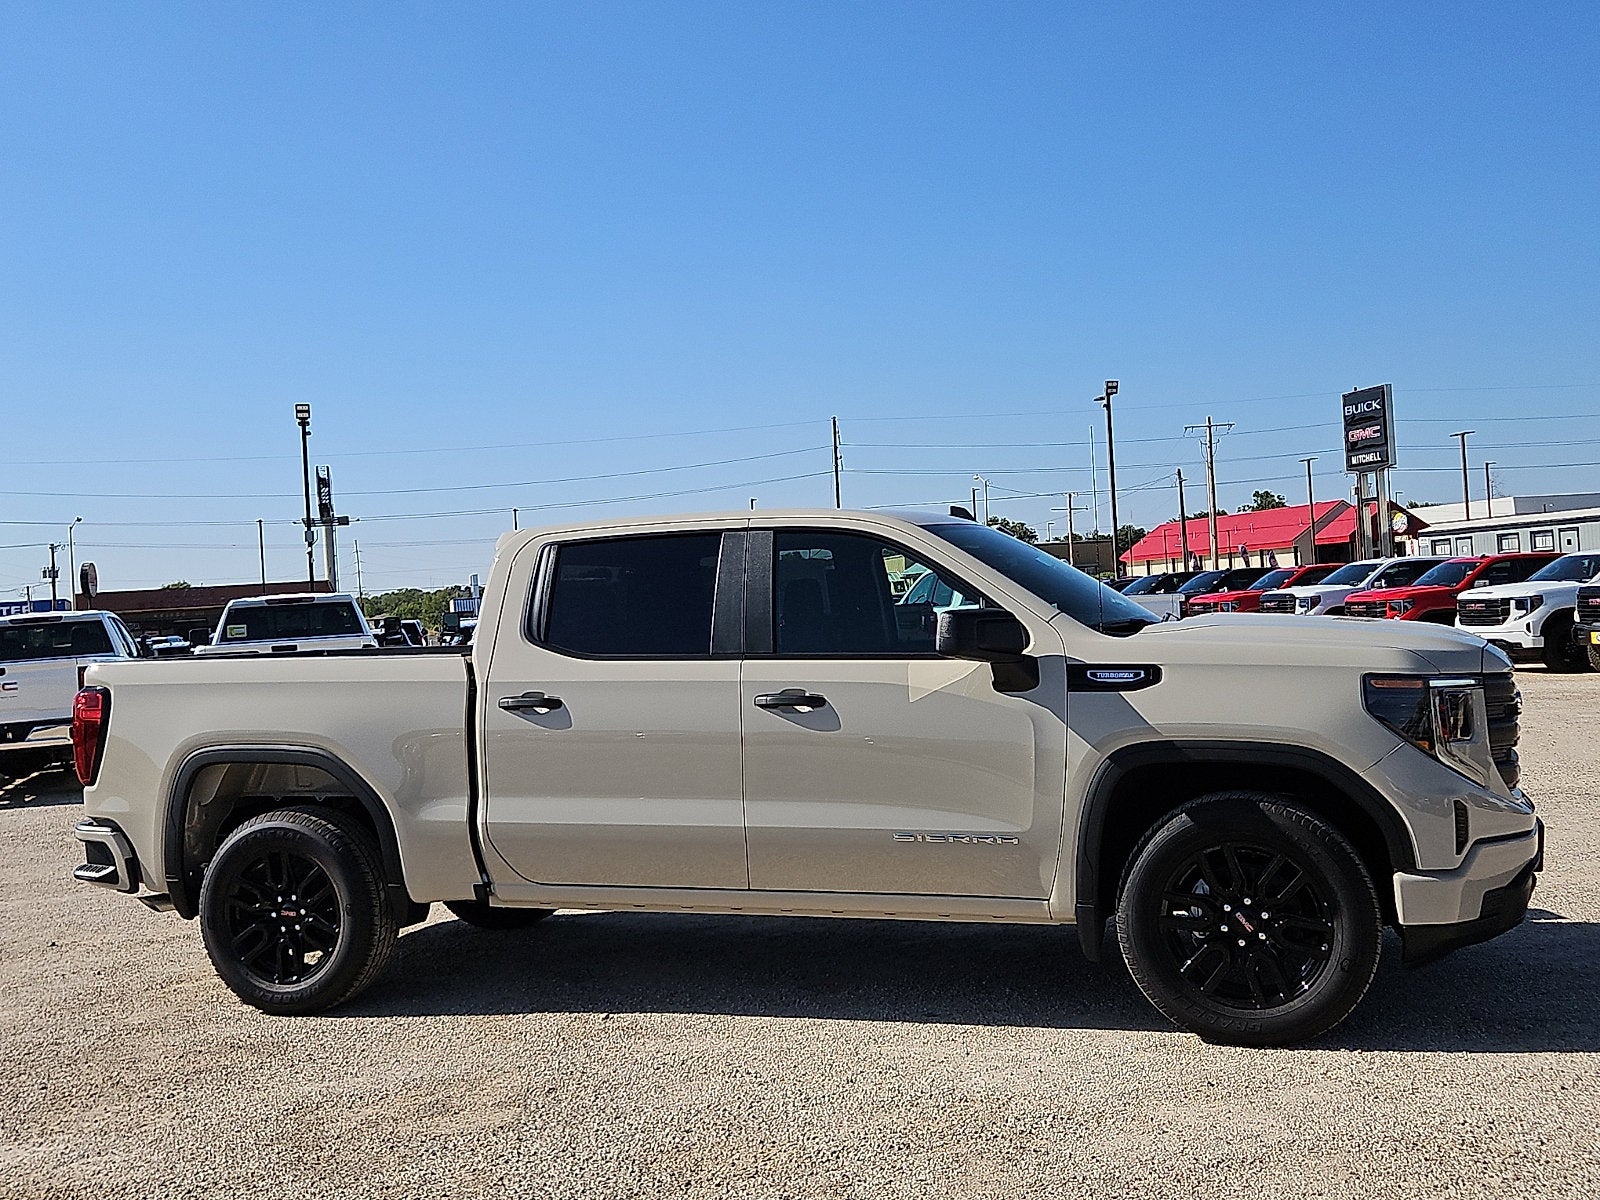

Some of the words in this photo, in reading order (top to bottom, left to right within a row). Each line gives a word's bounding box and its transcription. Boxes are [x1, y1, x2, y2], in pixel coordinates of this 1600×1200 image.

[1344, 398, 1382, 416] BUICK
[1348, 425, 1381, 442] GMC
[1351, 451, 1381, 465] MITCHELL
[893, 831, 1019, 845] SIERRA
[1235, 911, 1254, 933] GMC
